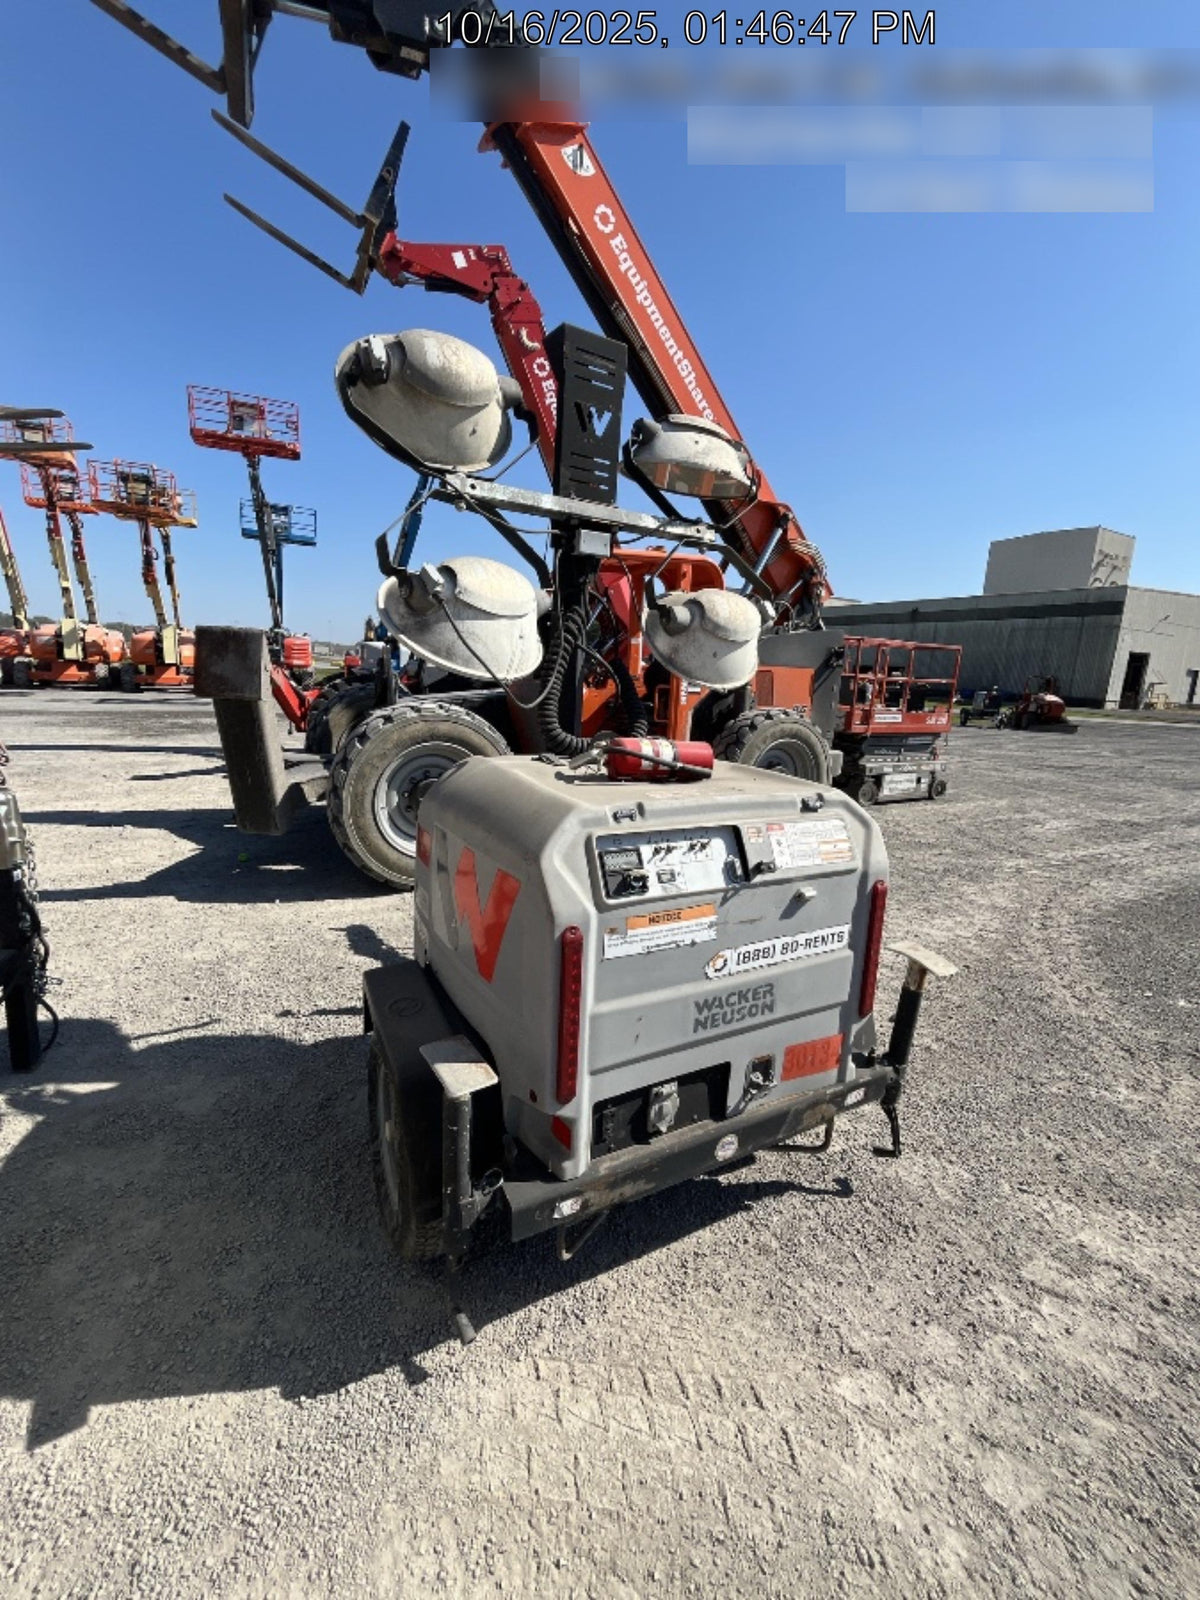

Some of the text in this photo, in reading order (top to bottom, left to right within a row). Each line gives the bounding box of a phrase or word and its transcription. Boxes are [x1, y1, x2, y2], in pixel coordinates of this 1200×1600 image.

[609, 233, 716, 421] EquipmentShare
[693, 999, 775, 1033] NEUSON
[694, 983, 774, 1015] WACKER
